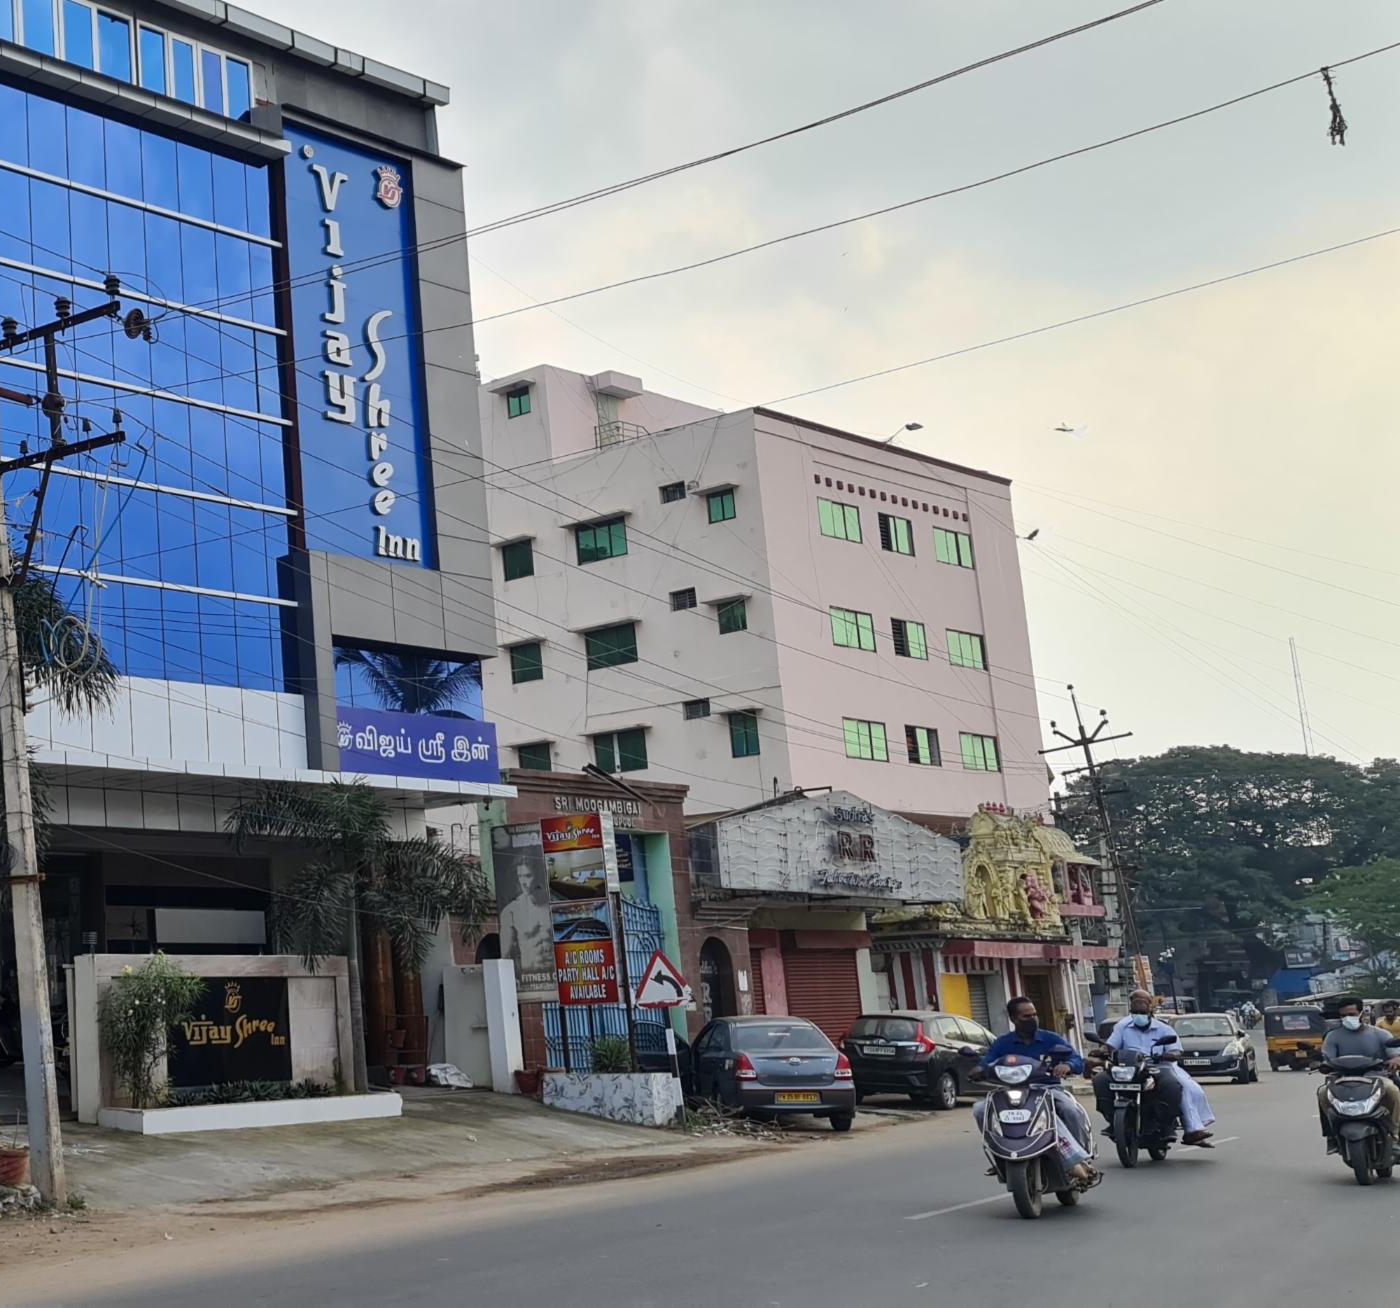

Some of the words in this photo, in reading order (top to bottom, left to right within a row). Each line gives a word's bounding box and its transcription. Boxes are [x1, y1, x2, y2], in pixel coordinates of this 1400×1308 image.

[365, 310, 395, 515] Shree
[377, 525, 421, 562] Inn
[355, 725, 412, 758] விஜய்
[451, 735, 490, 762] இன்
[554, 796, 572, 811] SRI
[546, 829, 571, 843] Vijay
[572, 826, 595, 842] Shree
[565, 951, 577, 965] A/C
[579, 949, 604, 964] ROOMS
[521, 972, 551, 982] FITNESS
[558, 968, 579, 982] PARTY
[582, 966, 599, 981] HALL
[601, 966, 615, 980] A/C
[570, 983, 607, 999] AVAILABLE
[182, 1014, 232, 1046] Vijay
[234, 1014, 276, 1049] Shree
[271, 1033, 286, 1046] Inn
